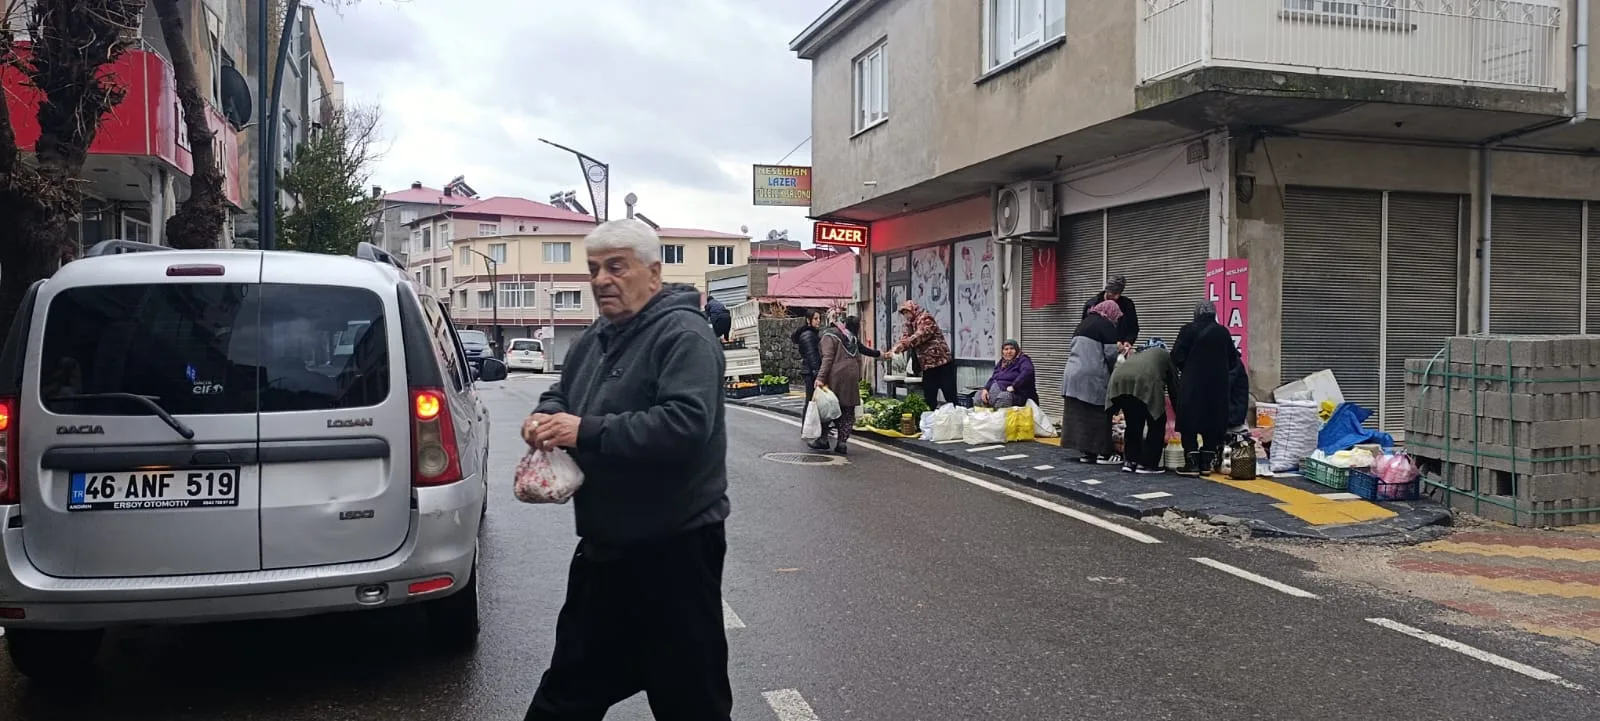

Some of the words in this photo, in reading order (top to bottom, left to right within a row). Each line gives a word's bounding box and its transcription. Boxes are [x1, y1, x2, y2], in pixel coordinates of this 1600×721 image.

[768, 177, 797, 187] LAZER
[821, 227, 863, 242] LAZER
[1228, 281, 1243, 354] LAZ
[327, 418, 373, 428] LOGAN
[56, 425, 105, 434] DACIA
[86, 475, 116, 500] 46
[125, 473, 174, 499] ANF
[187, 472, 233, 497] 519
[73, 490, 84, 498] TR
[113, 501, 142, 509] ERSOY
